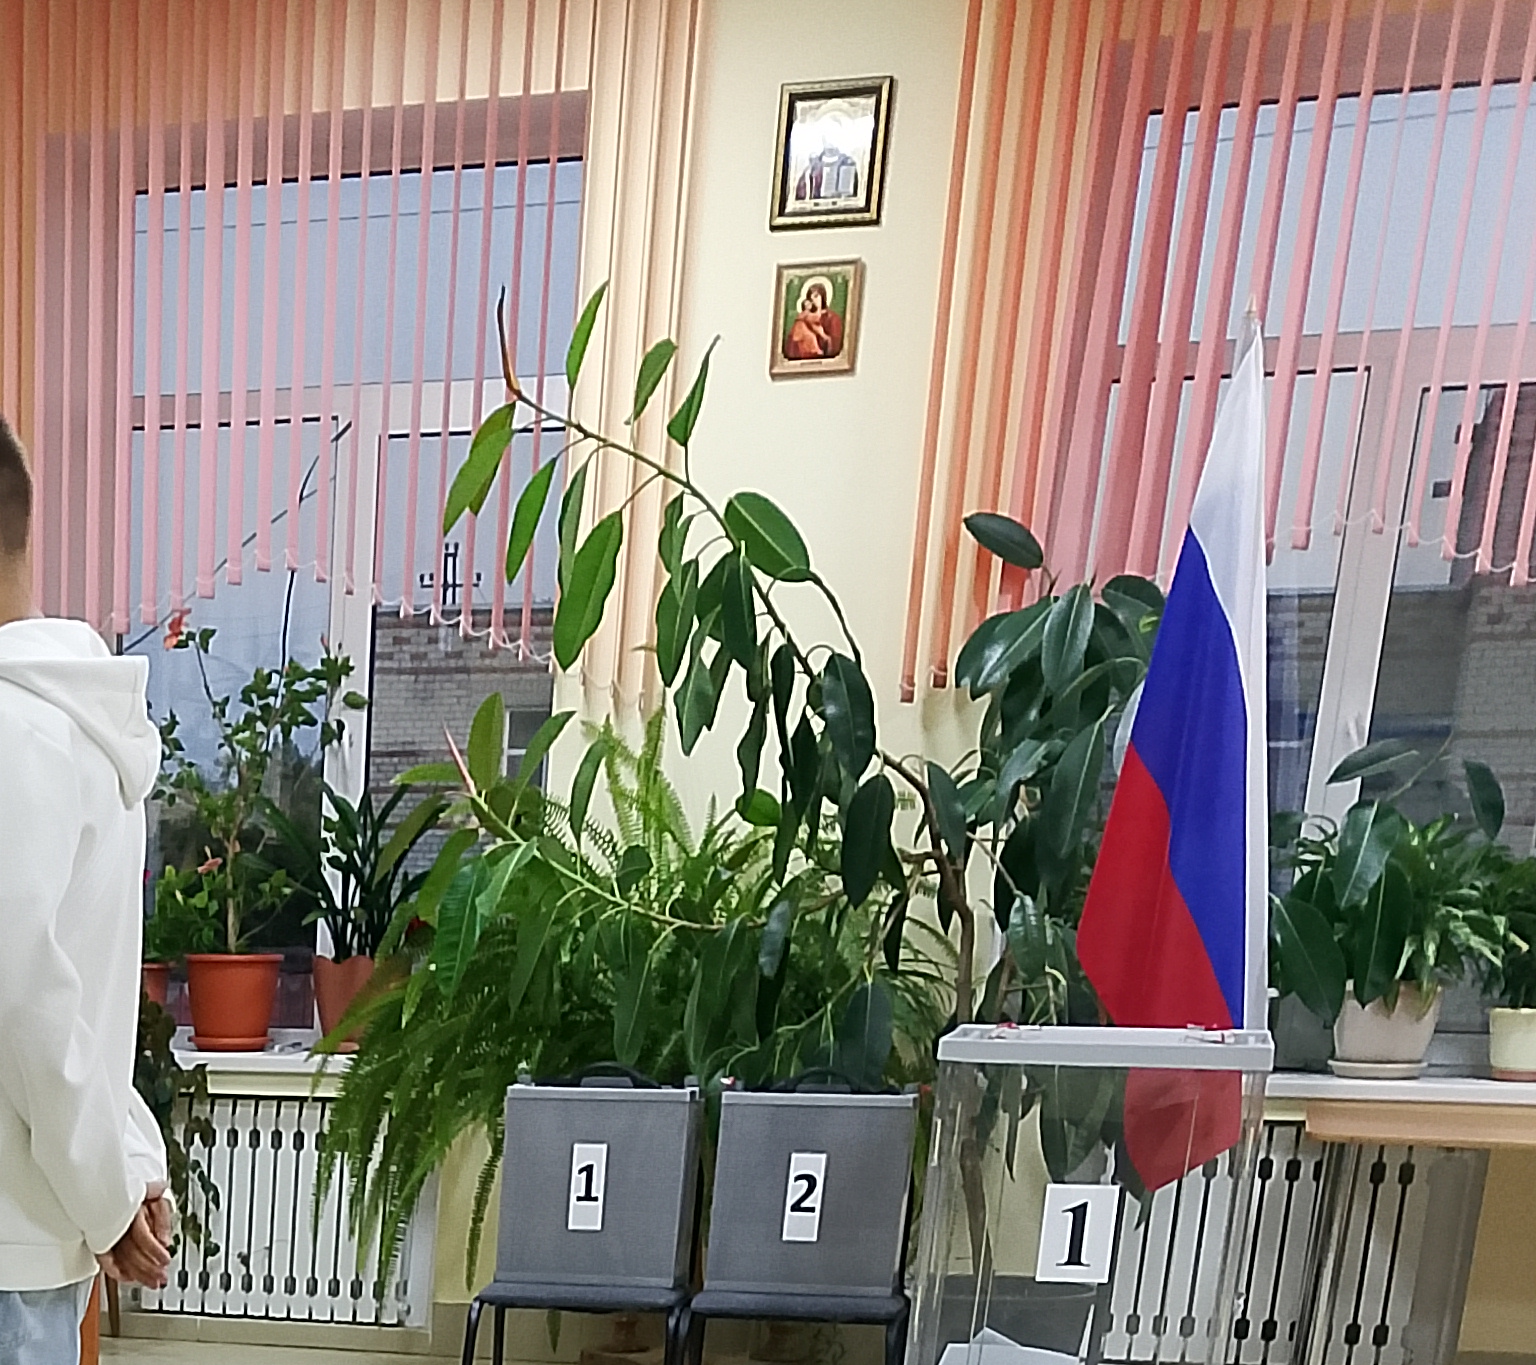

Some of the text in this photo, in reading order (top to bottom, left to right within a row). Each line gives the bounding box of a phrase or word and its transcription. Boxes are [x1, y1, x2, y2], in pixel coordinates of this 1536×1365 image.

[576, 1163, 599, 1202] 1
[790, 1173, 818, 1213] 2
[1055, 1200, 1092, 1268] 1
